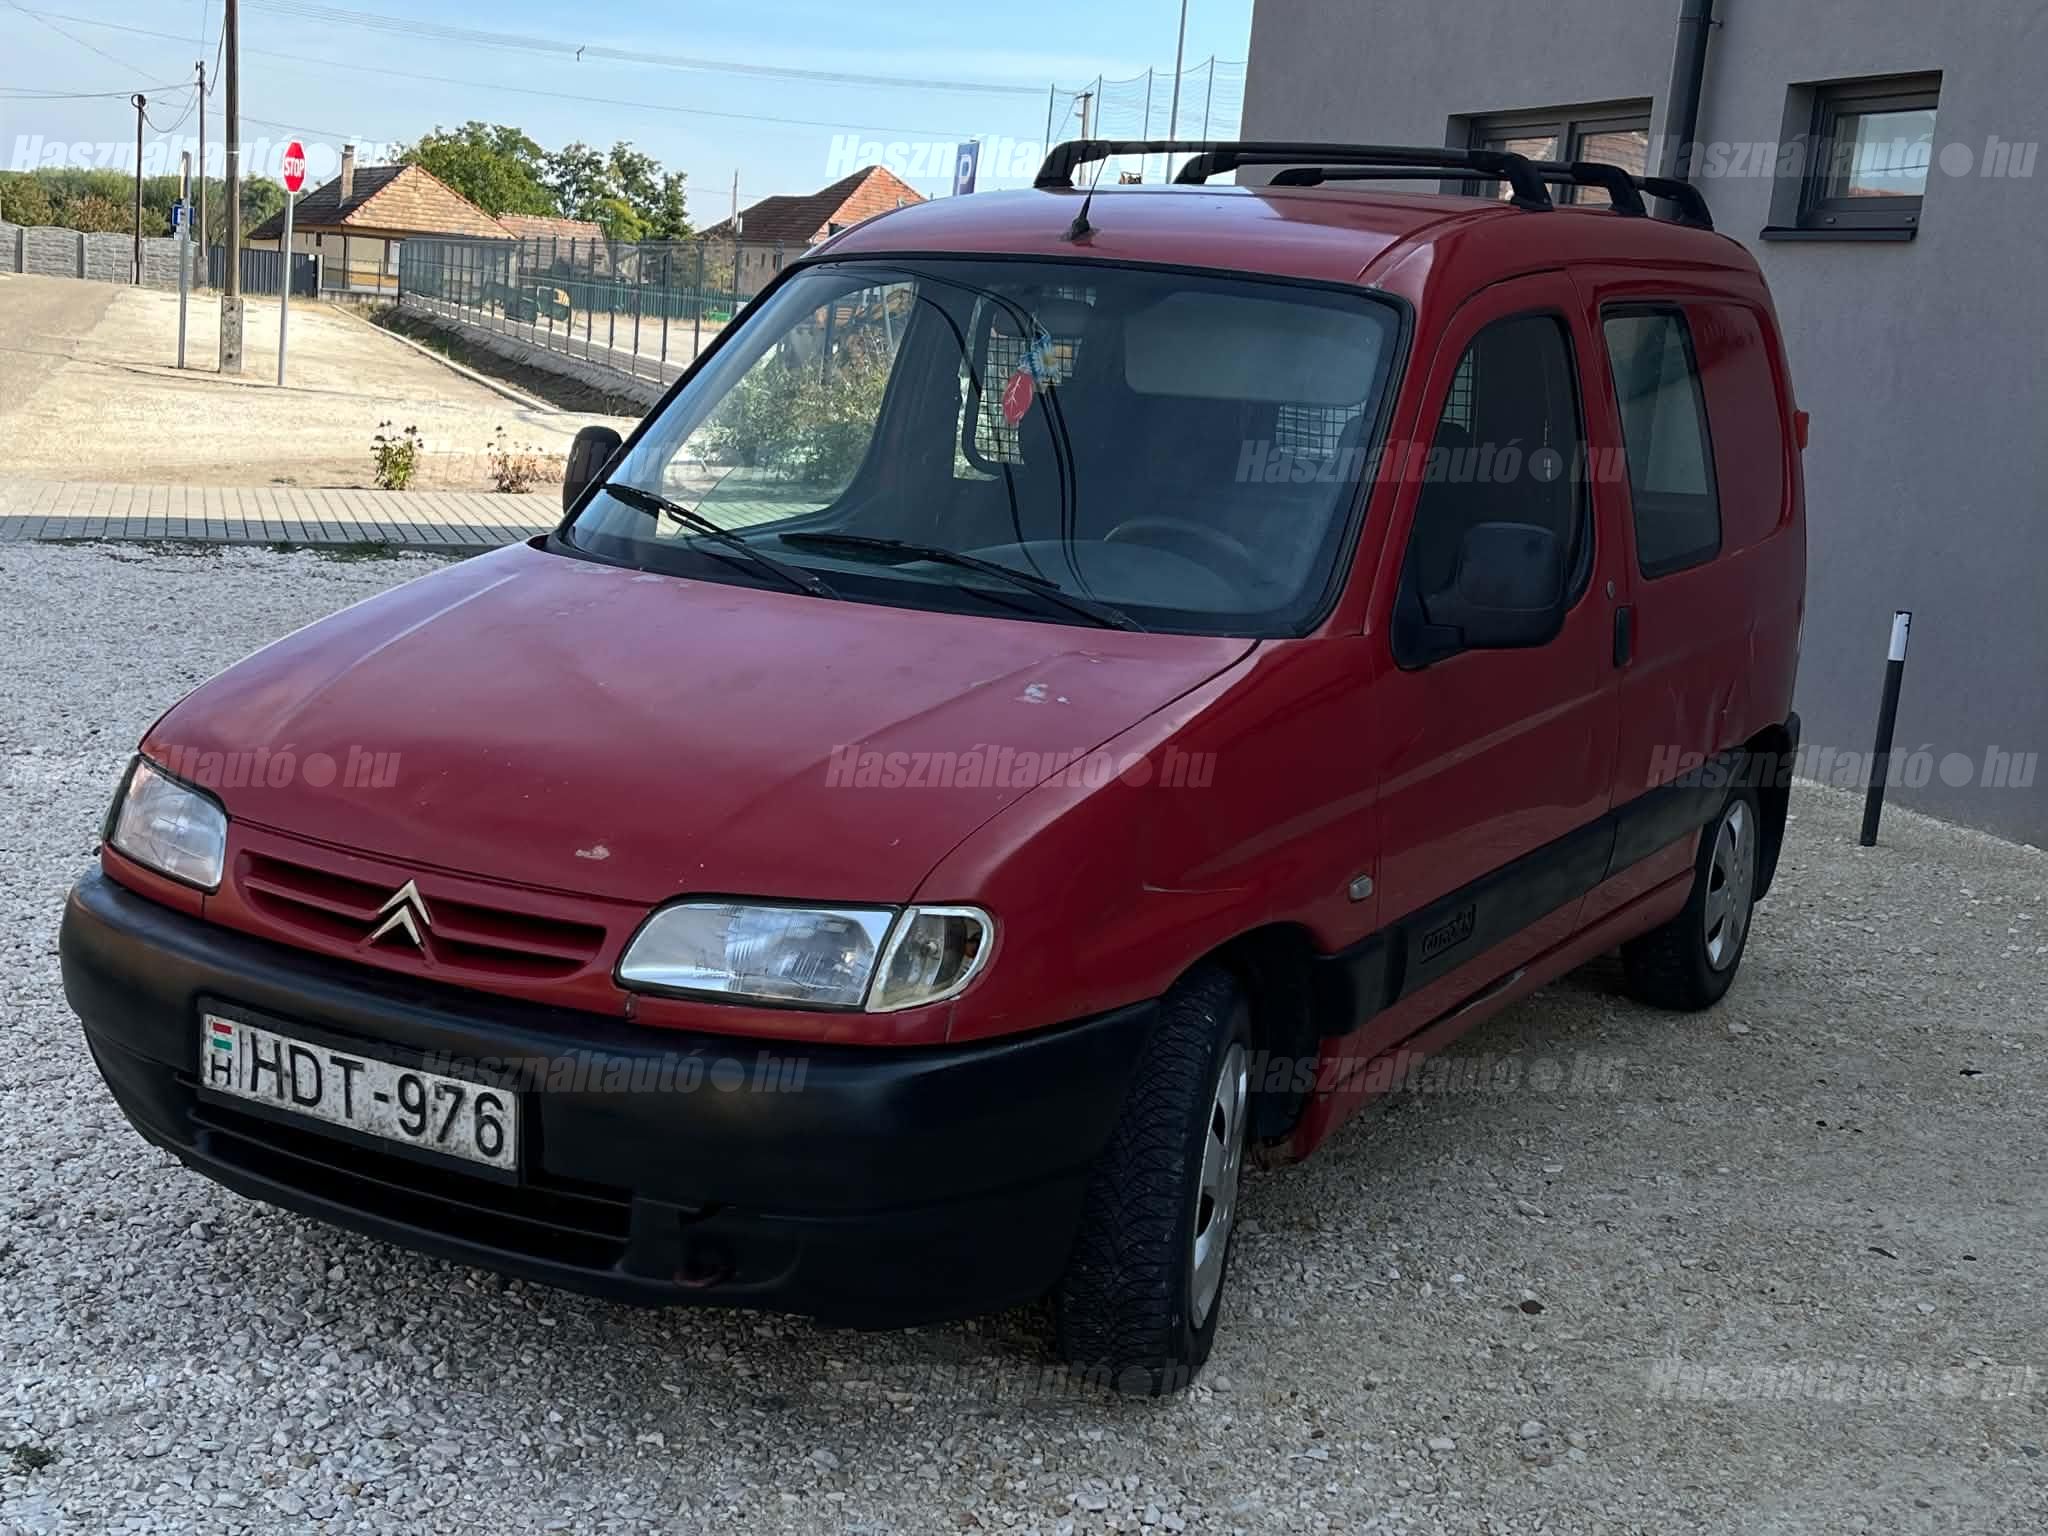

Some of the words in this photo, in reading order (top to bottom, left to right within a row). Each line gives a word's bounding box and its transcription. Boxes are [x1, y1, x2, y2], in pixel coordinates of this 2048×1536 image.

[284, 157, 304, 177] STOP
[211, 1054, 232, 1085] H
[251, 1031, 504, 1157] HDT-976
